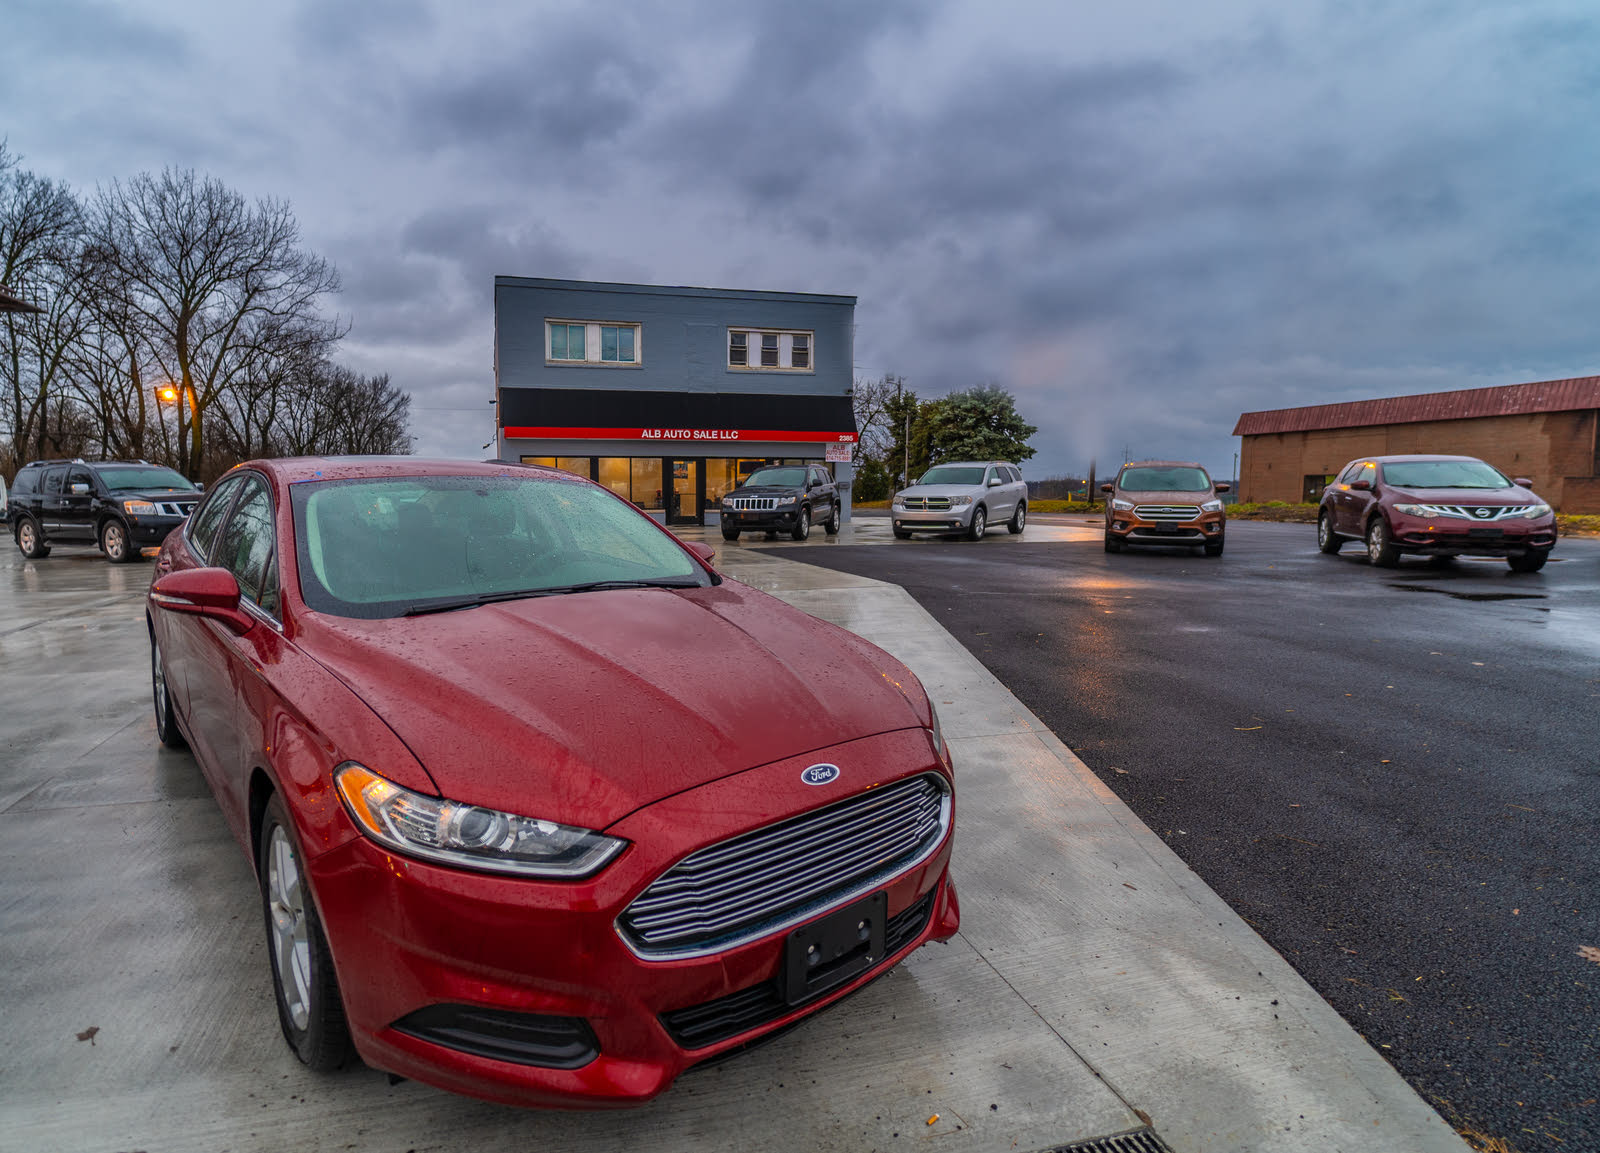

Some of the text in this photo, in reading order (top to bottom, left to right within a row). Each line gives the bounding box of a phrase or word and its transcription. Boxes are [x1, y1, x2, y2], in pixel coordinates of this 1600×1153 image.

[641, 429, 739, 439] ALB AUTO SALE LLC
[810, 767, 833, 782] Ford
